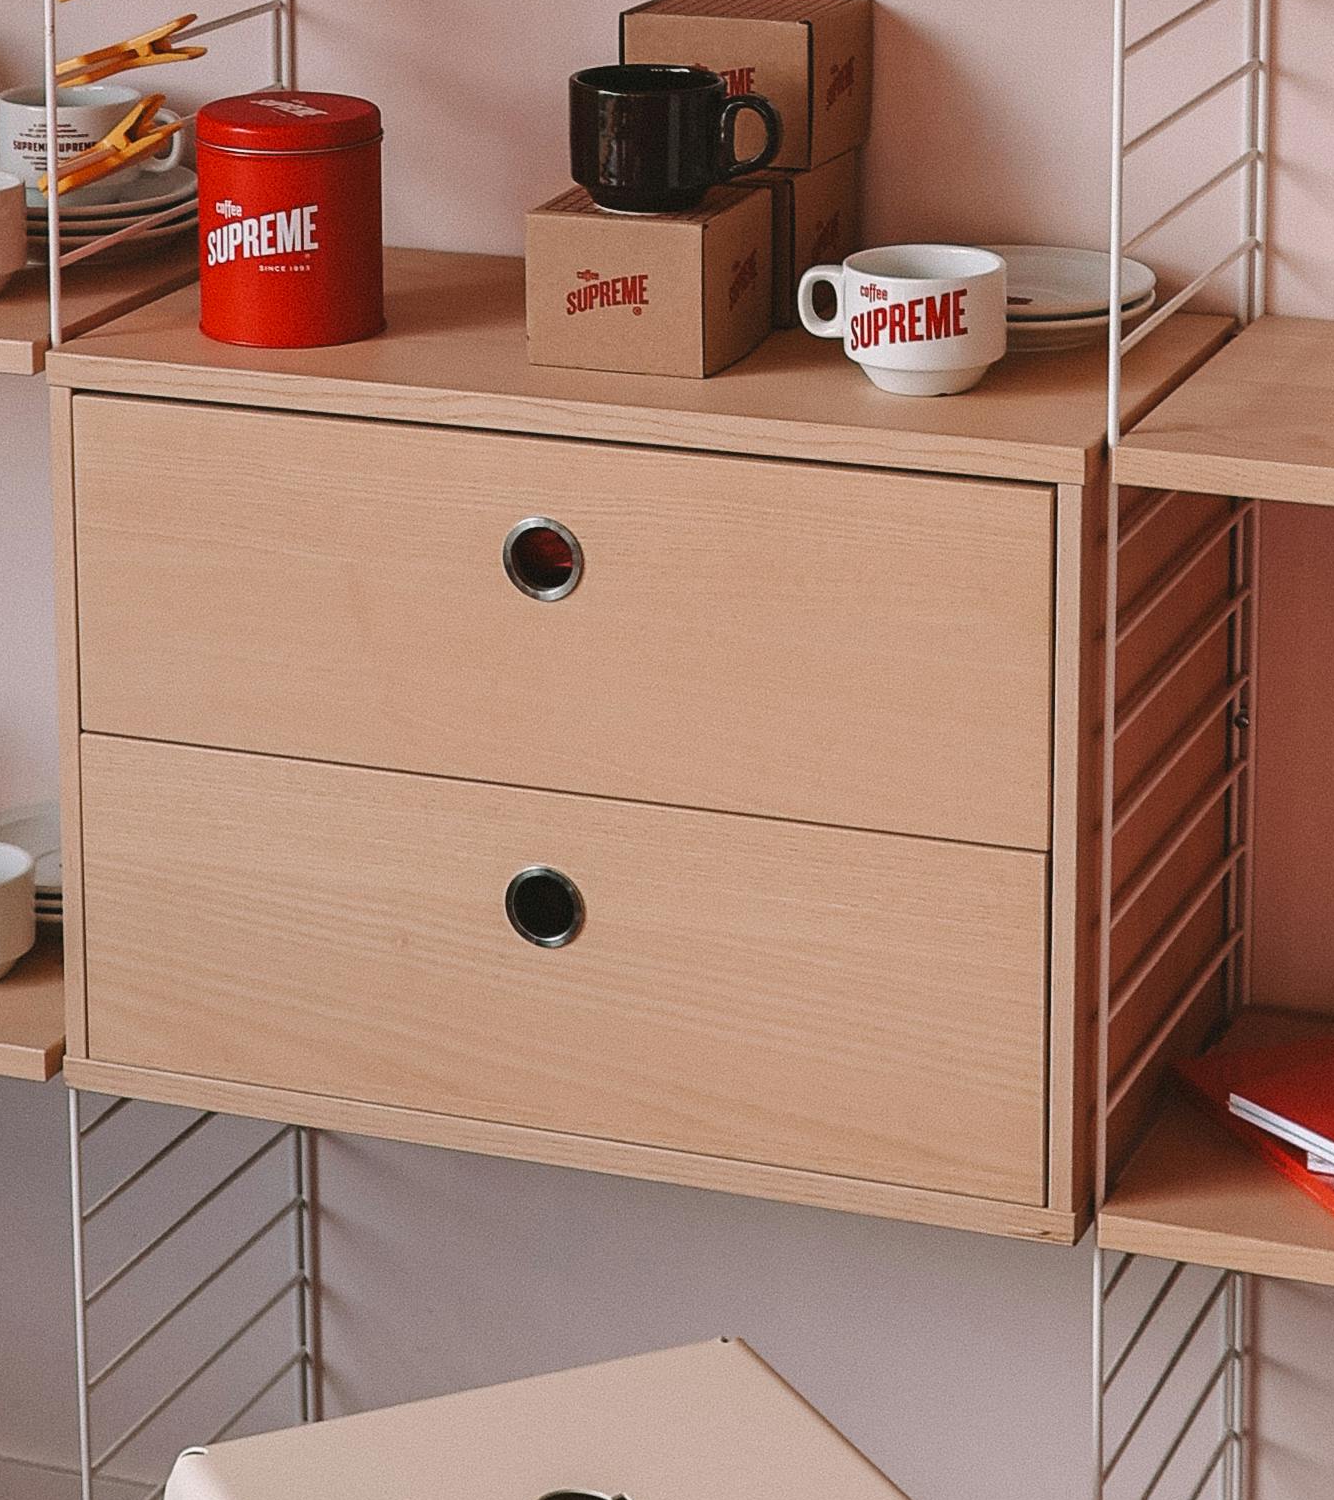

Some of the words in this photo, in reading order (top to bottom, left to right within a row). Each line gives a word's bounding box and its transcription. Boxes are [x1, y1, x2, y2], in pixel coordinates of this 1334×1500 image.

[215, 198, 243, 219] coffee
[206, 204, 319, 267] SUPREME
[258, 264, 287, 273] SINCE
[565, 273, 650, 316] SUPREME
[859, 282, 889, 304] coffee
[849, 288, 969, 352] SUPREME
